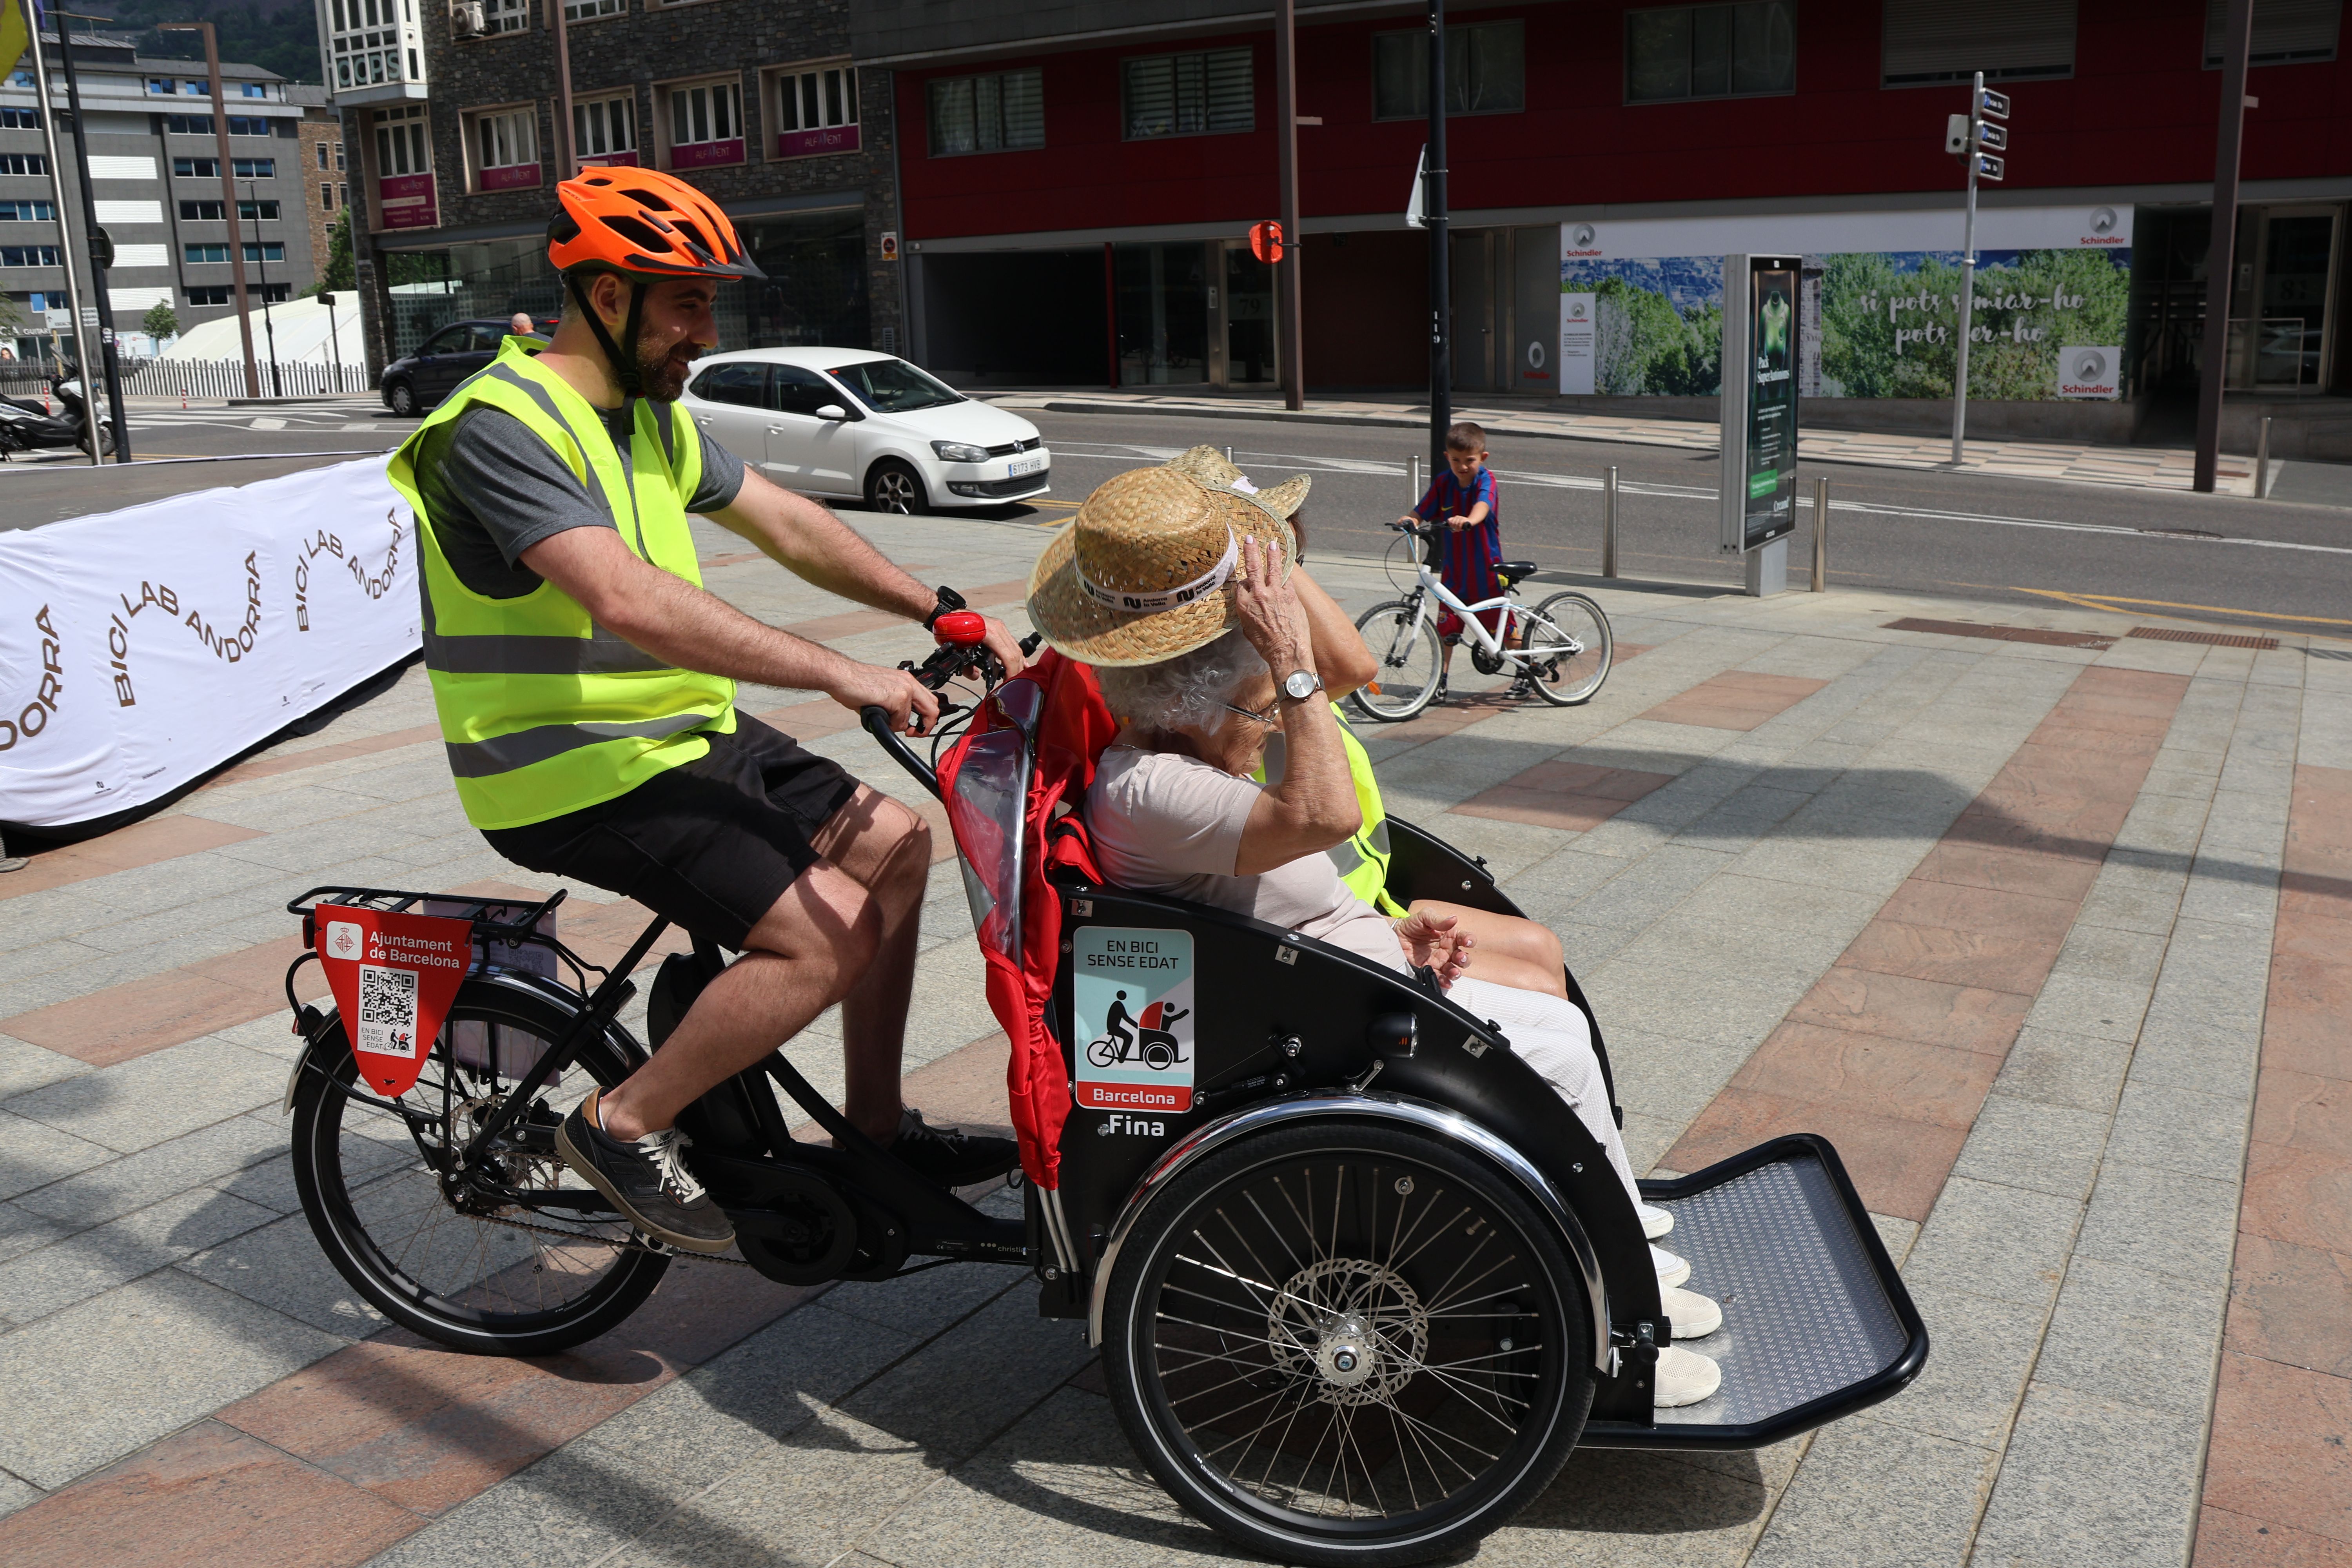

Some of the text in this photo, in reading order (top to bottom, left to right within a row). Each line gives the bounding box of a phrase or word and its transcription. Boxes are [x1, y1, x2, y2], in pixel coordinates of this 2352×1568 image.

[1239, 298, 1261, 315] 79
[1860, 283, 2087, 323] si pots smiar-ho
[1895, 316, 2046, 355] pots er-ho
[1758, 356, 1769, 368] Pack
[2062, 384, 2114, 394] Schindler
[1013, 459, 1041, 474] 6173 HVB
[295, 507, 403, 632] BICI LAB ANDORRA
[1195, 575, 1216, 590] Andorra
[1202, 581, 1216, 593] Vella
[1096, 589, 1115, 600] Andorra
[109, 550, 262, 707] BICI LAB ANDORRA
[369, 931, 452, 953] Ajuntament
[1107, 940, 1158, 953] EN BICI
[369, 948, 460, 969] de Barcelona
[1087, 955, 1179, 969] SENSE EDAT
[363, 1035, 383, 1043] SENSE
[1093, 1088, 1175, 1105] Barcelona
[1109, 1114, 1165, 1137] Fina
